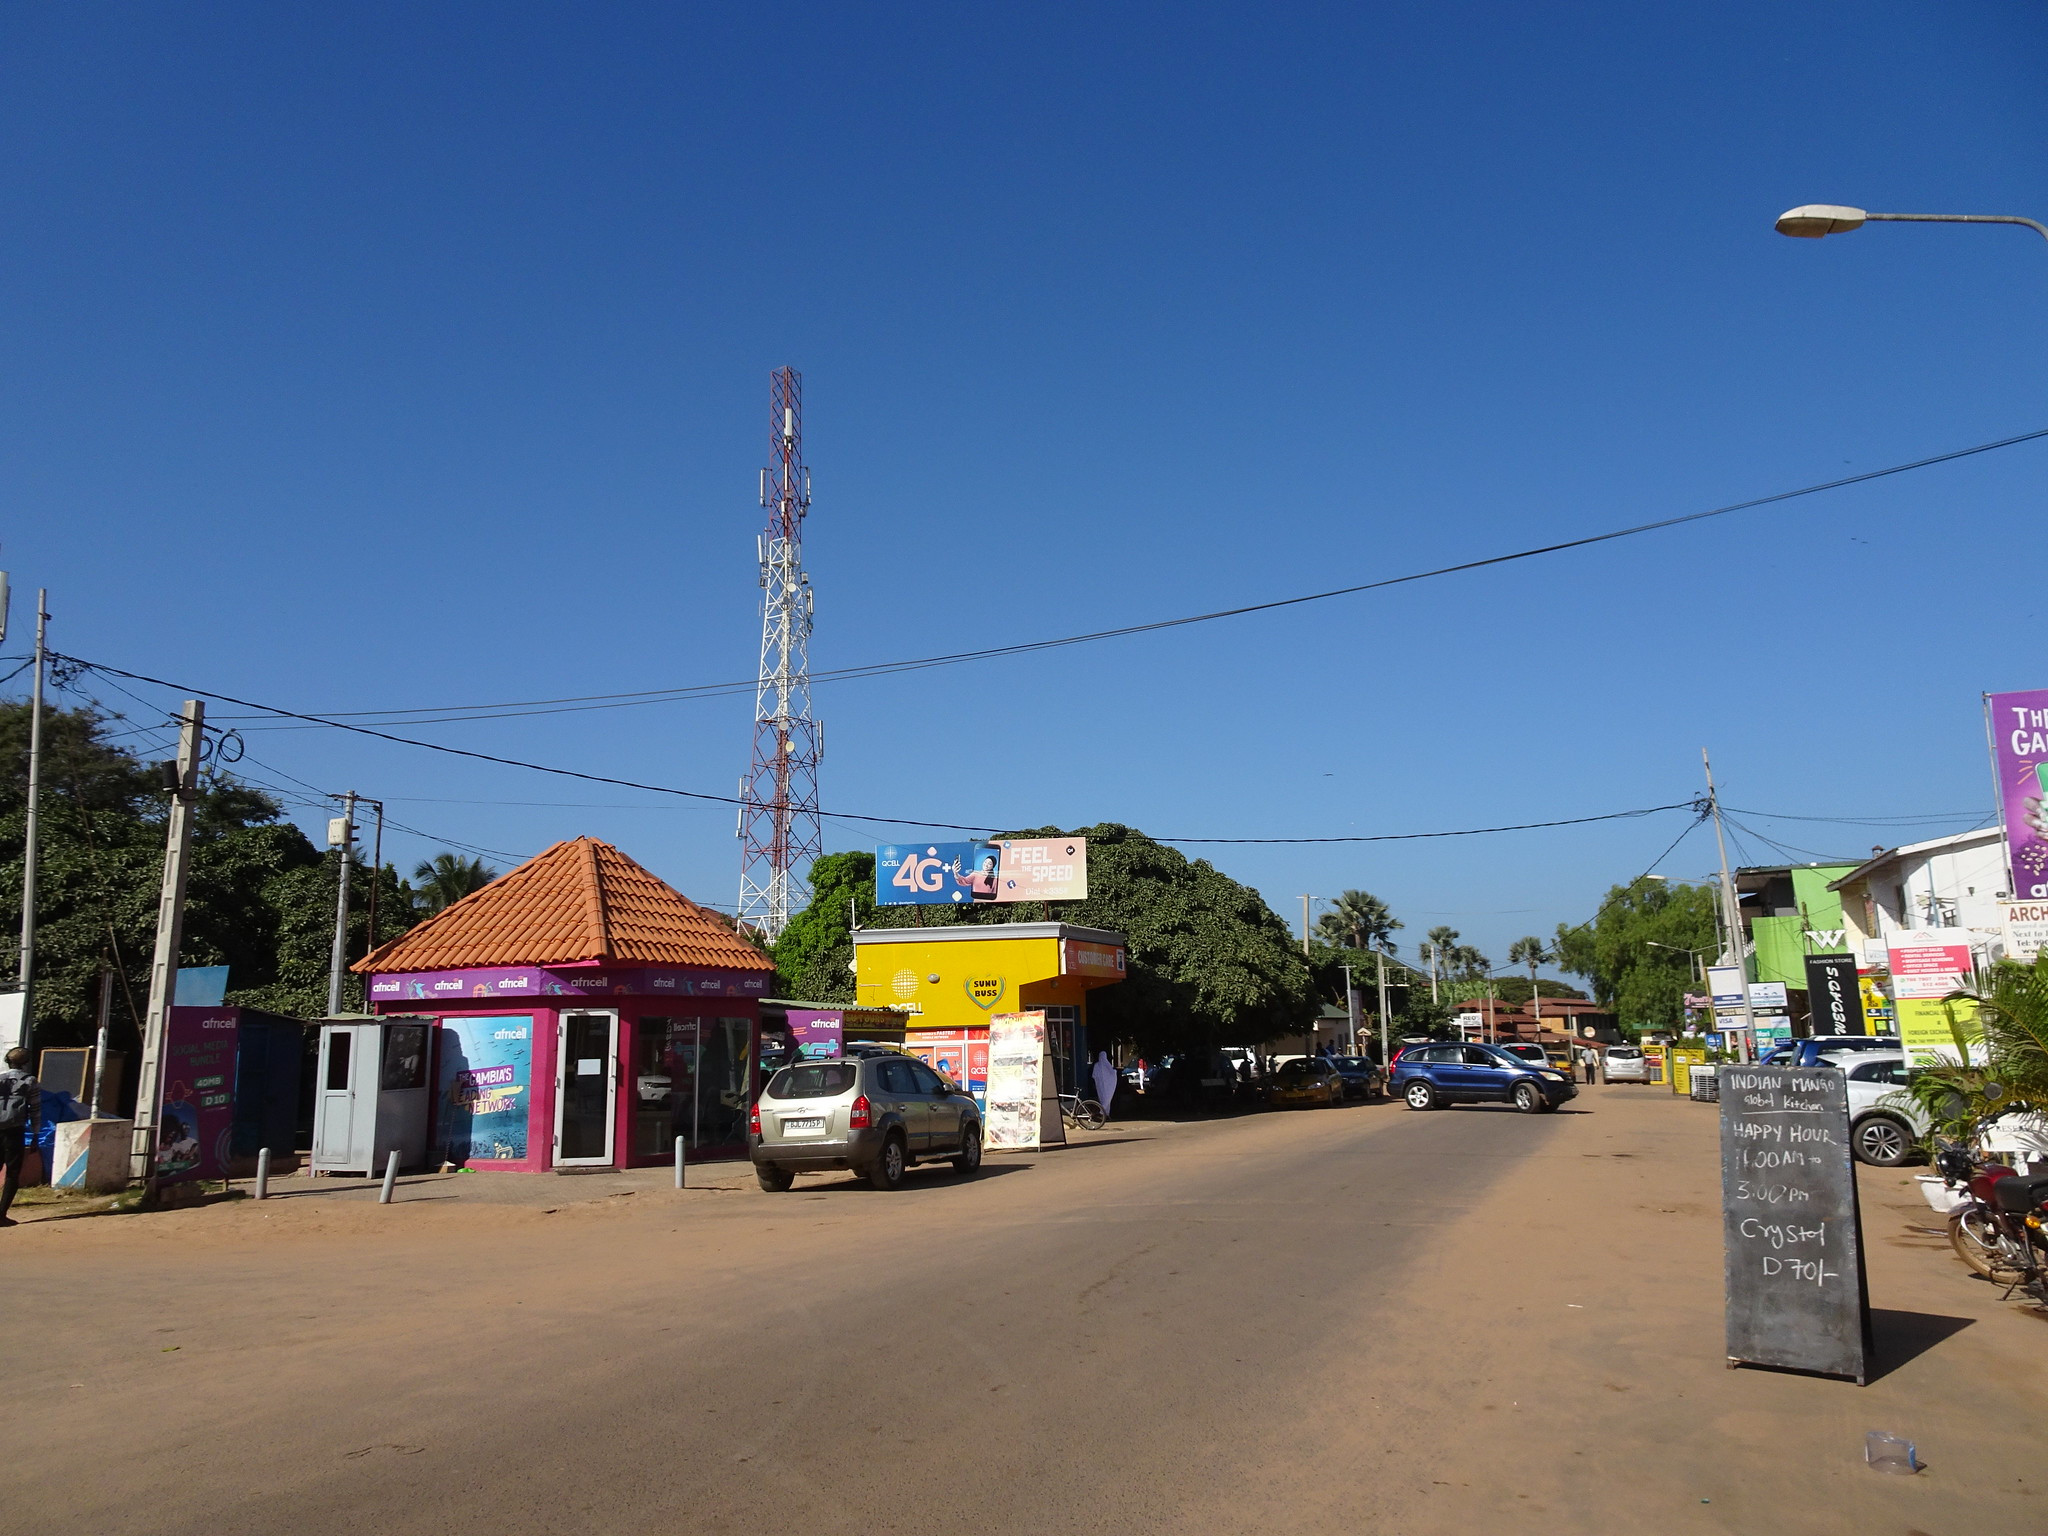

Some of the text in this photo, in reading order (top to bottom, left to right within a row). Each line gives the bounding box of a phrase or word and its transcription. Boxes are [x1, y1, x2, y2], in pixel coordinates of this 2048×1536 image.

[2011, 729, 2048, 756] GA
[1010, 846, 1053, 865] FEEL
[1021, 864, 1074, 883] THE SPEED
[2017, 939, 2031, 947] Tel:
[373, 979, 400, 992] africell
[434, 977, 463, 991] africell
[498, 975, 528, 989] africell
[571, 976, 608, 988] africell
[653, 977, 675, 988] africell
[701, 979, 721, 989] africell
[744, 978, 763, 989] africell
[974, 980, 998, 988] SUNU
[974, 989, 998, 998] BUSS
[202, 1016, 236, 1029] africell
[811, 1017, 840, 1029] africell
[494, 1025, 528, 1040] africell
[196, 1077, 221, 1087] 40MB
[469, 1067, 513, 1086] GAMBIA'S
[1731, 1074, 1835, 1093] INDIAN MANGO
[468, 1097, 517, 1115] NETWORK
[1733, 1121, 1838, 1146] HAPPY HOUR
[1740, 1217, 1825, 1250] Crystal
